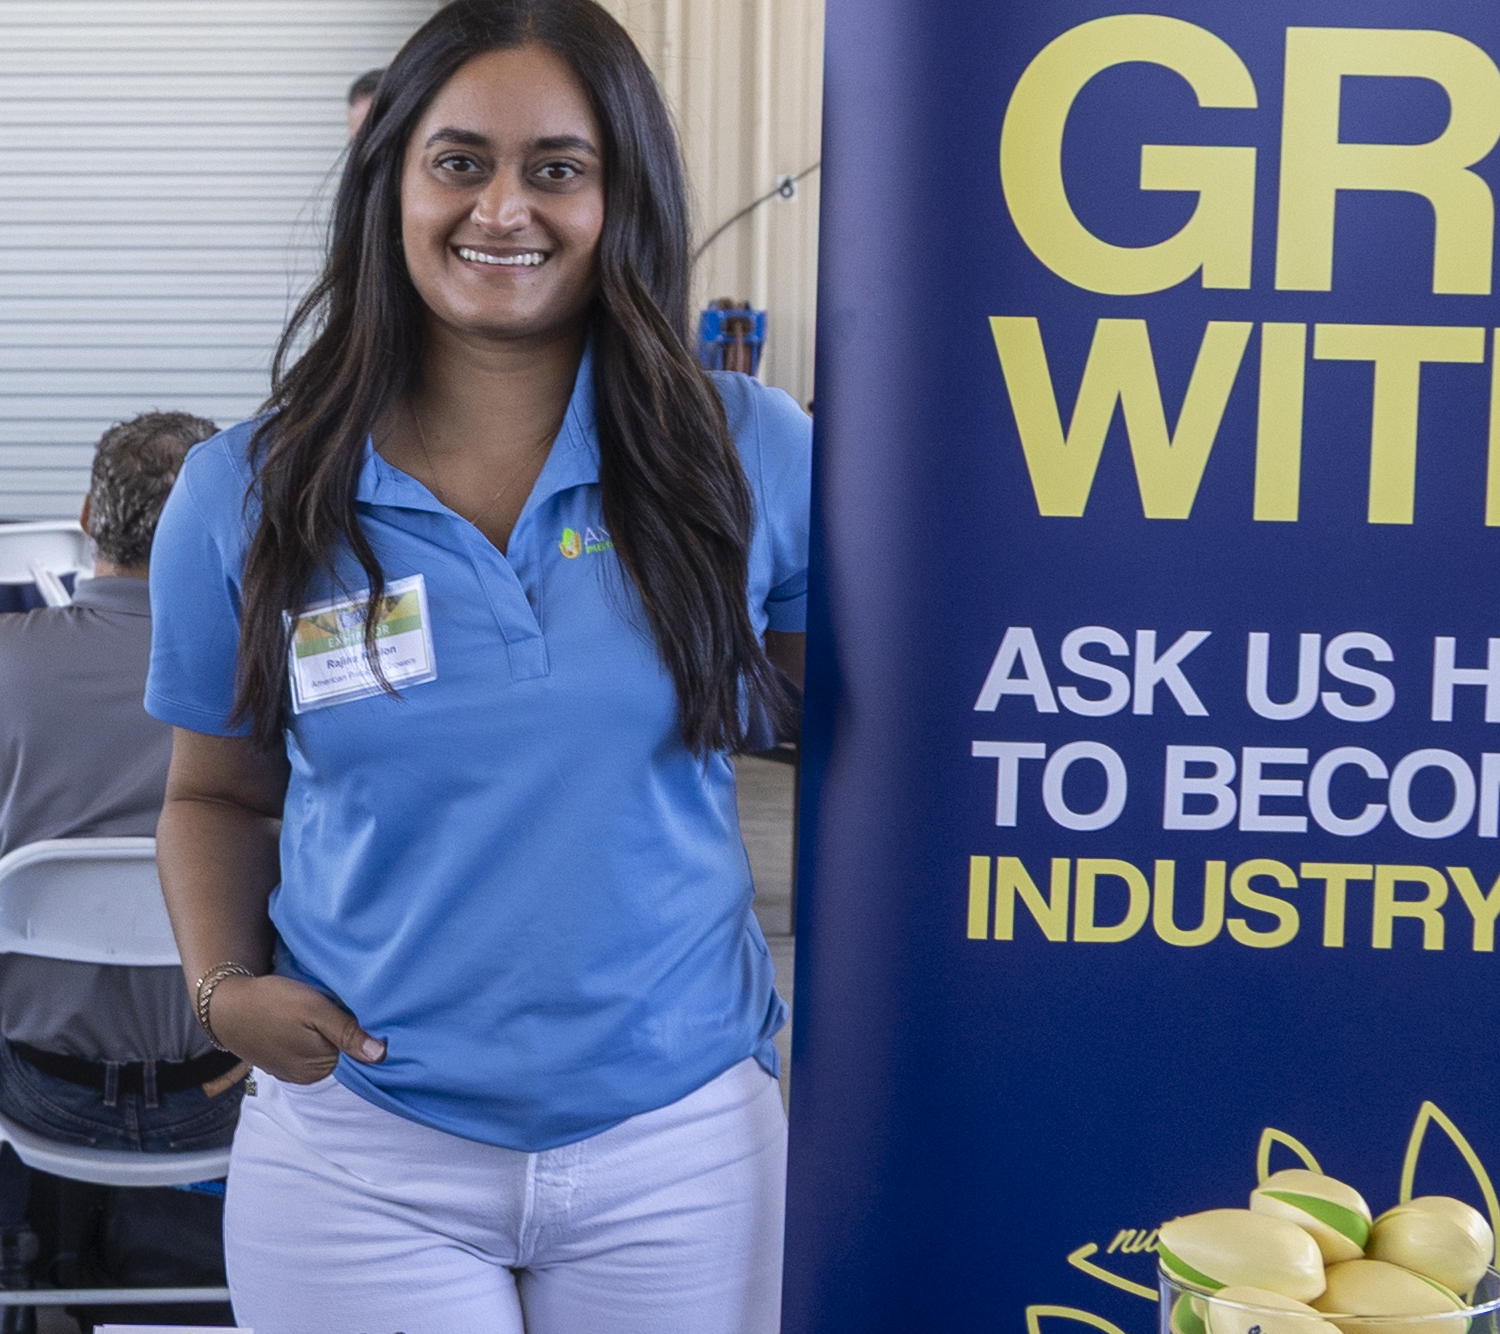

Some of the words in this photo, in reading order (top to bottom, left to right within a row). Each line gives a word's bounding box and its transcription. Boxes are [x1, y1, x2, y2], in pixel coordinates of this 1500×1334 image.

[974, 625, 1210, 718] ASK
[1244, 631, 1395, 723] US
[972, 740, 1128, 833] TO
